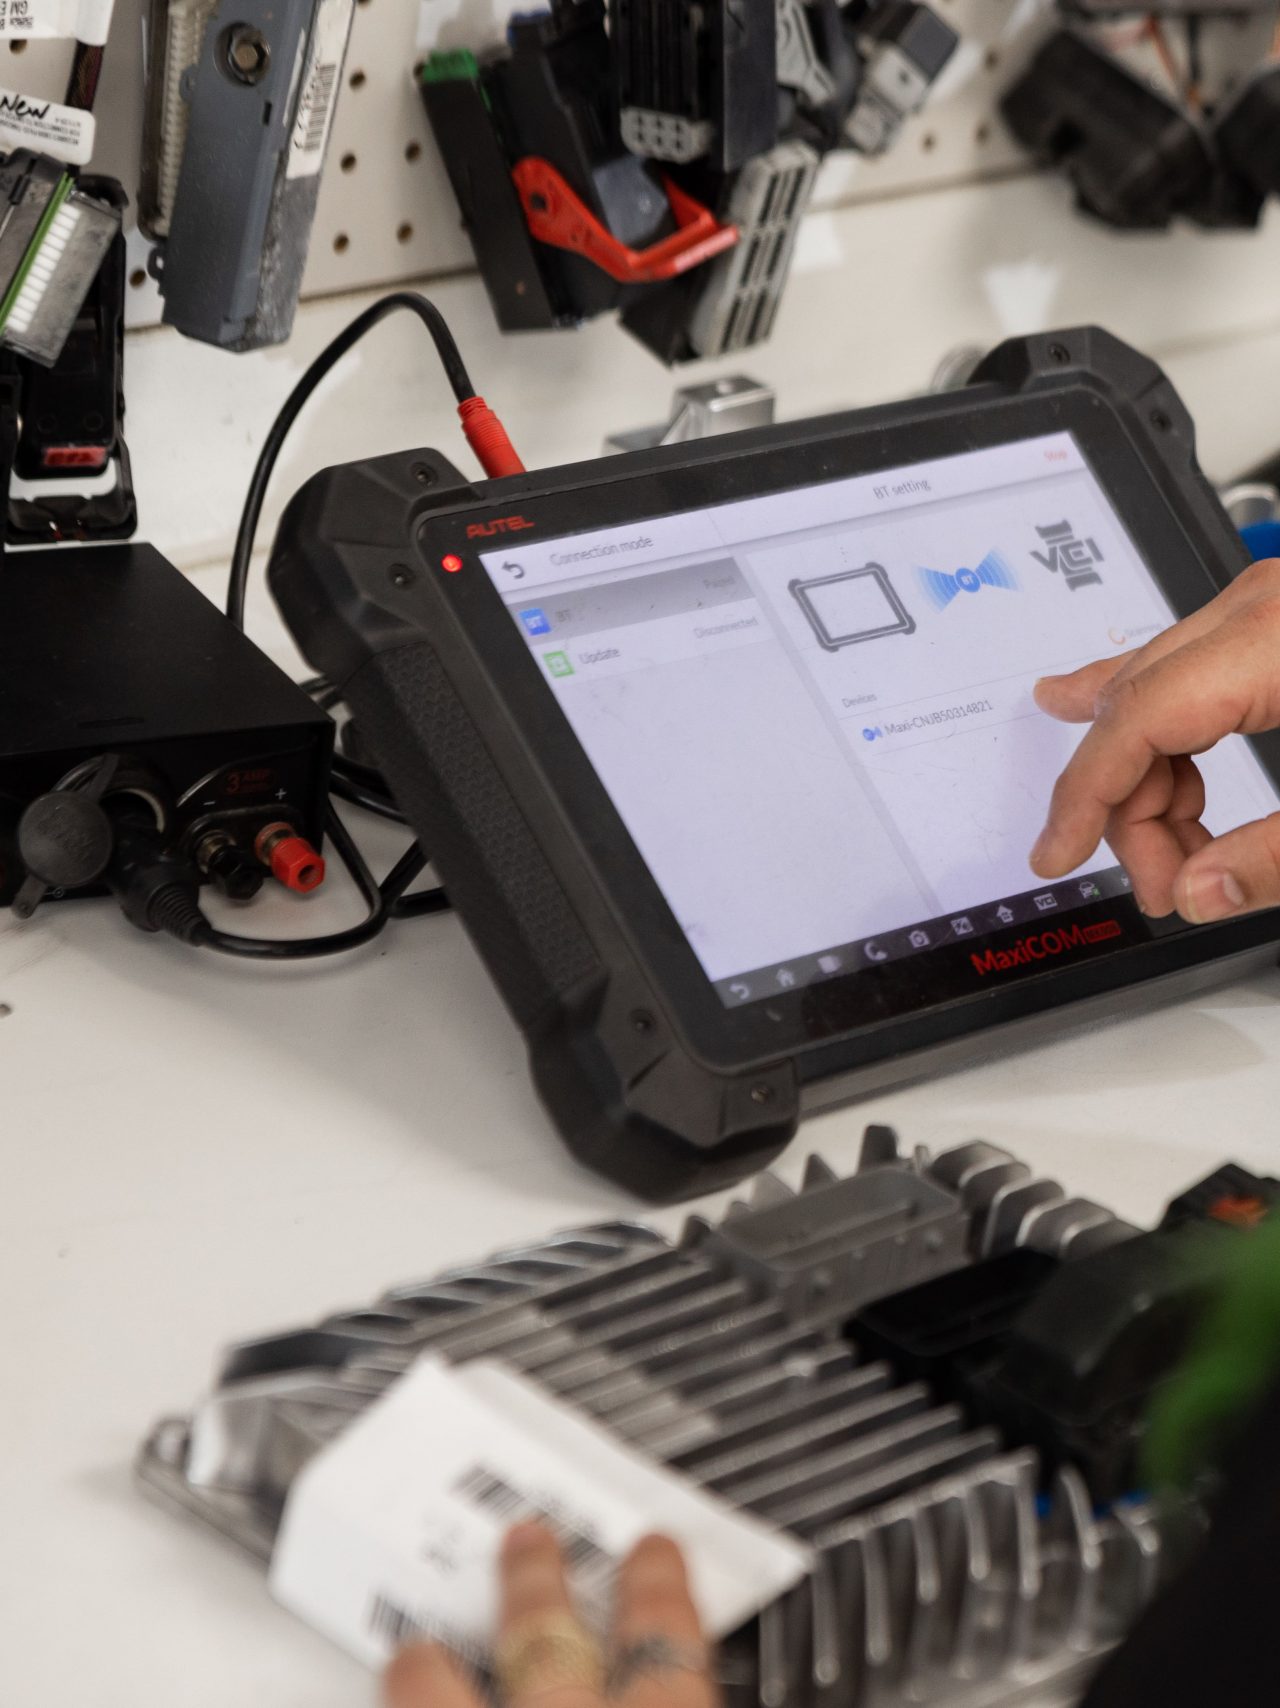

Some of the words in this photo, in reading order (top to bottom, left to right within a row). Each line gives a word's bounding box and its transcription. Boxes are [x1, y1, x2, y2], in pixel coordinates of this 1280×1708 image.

[0, 94, 50, 119] New
[873, 486, 890, 499] BT
[892, 479, 932, 496] setting
[466, 516, 535, 539] AUTEL
[550, 544, 619, 567] Connection
[619, 536, 654, 552] mode
[578, 647, 621, 665] Update
[970, 924, 1086, 975] MaxiCOM
